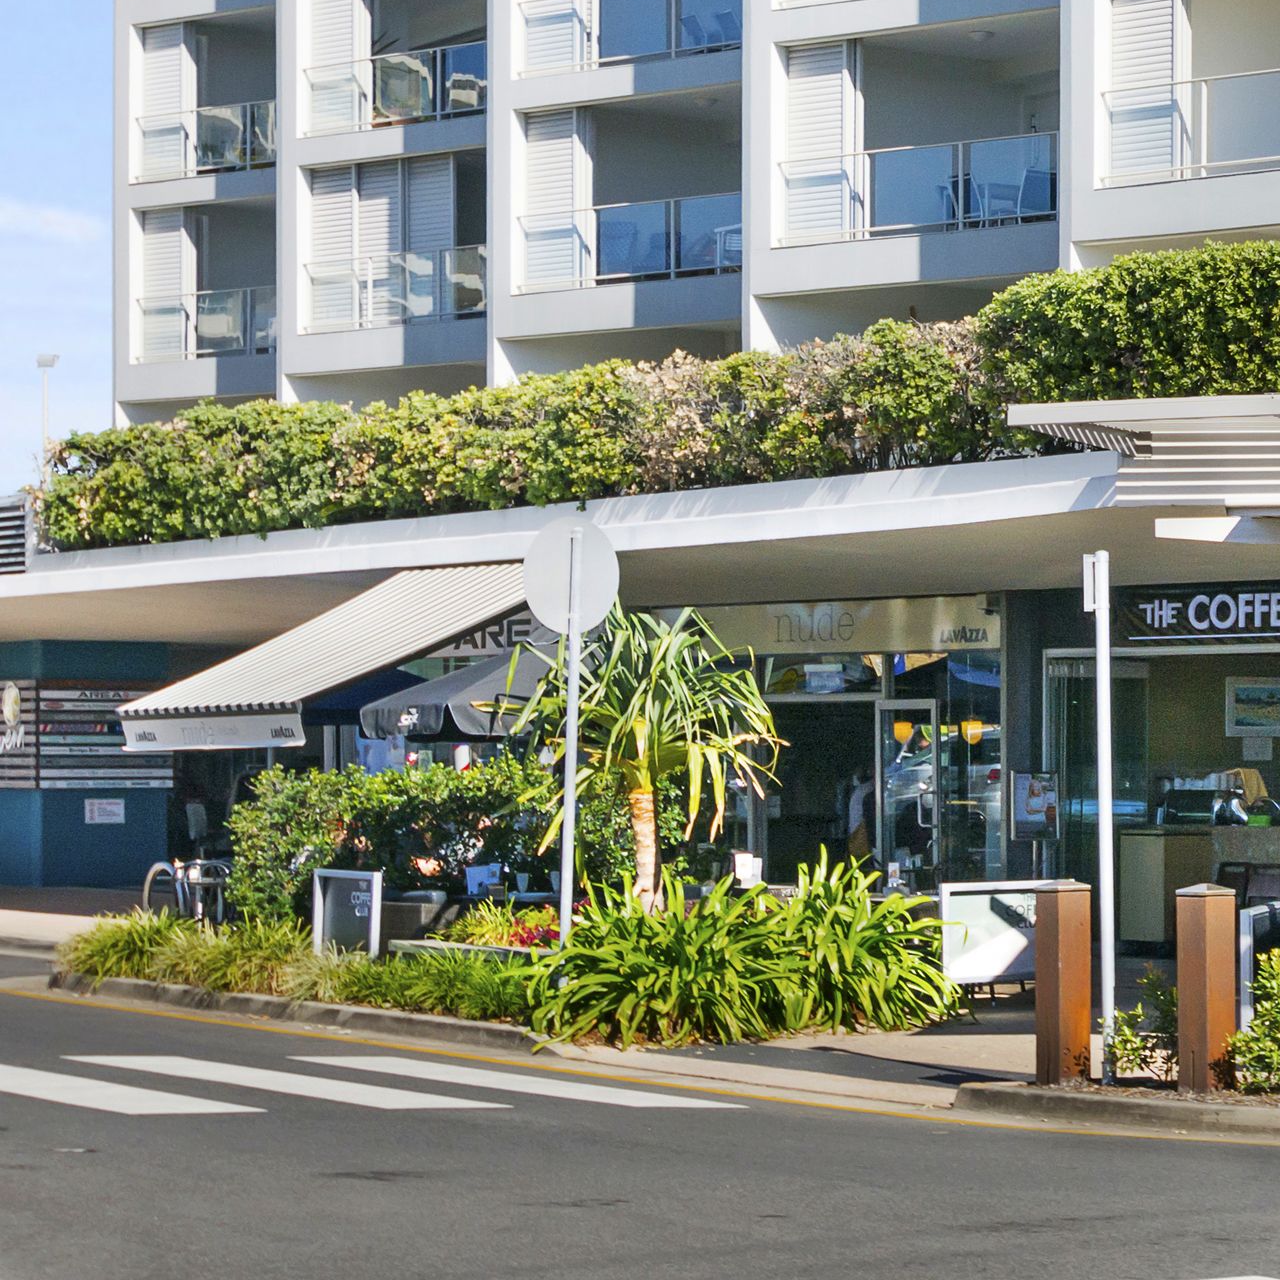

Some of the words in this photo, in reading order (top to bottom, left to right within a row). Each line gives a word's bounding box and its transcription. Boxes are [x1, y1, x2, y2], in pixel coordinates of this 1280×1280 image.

[773, 604, 855, 643] nude
[1138, 599, 1182, 628] THE
[940, 626, 988, 644] LAVAZZA
[270, 726, 296, 739] LAVAZZA
